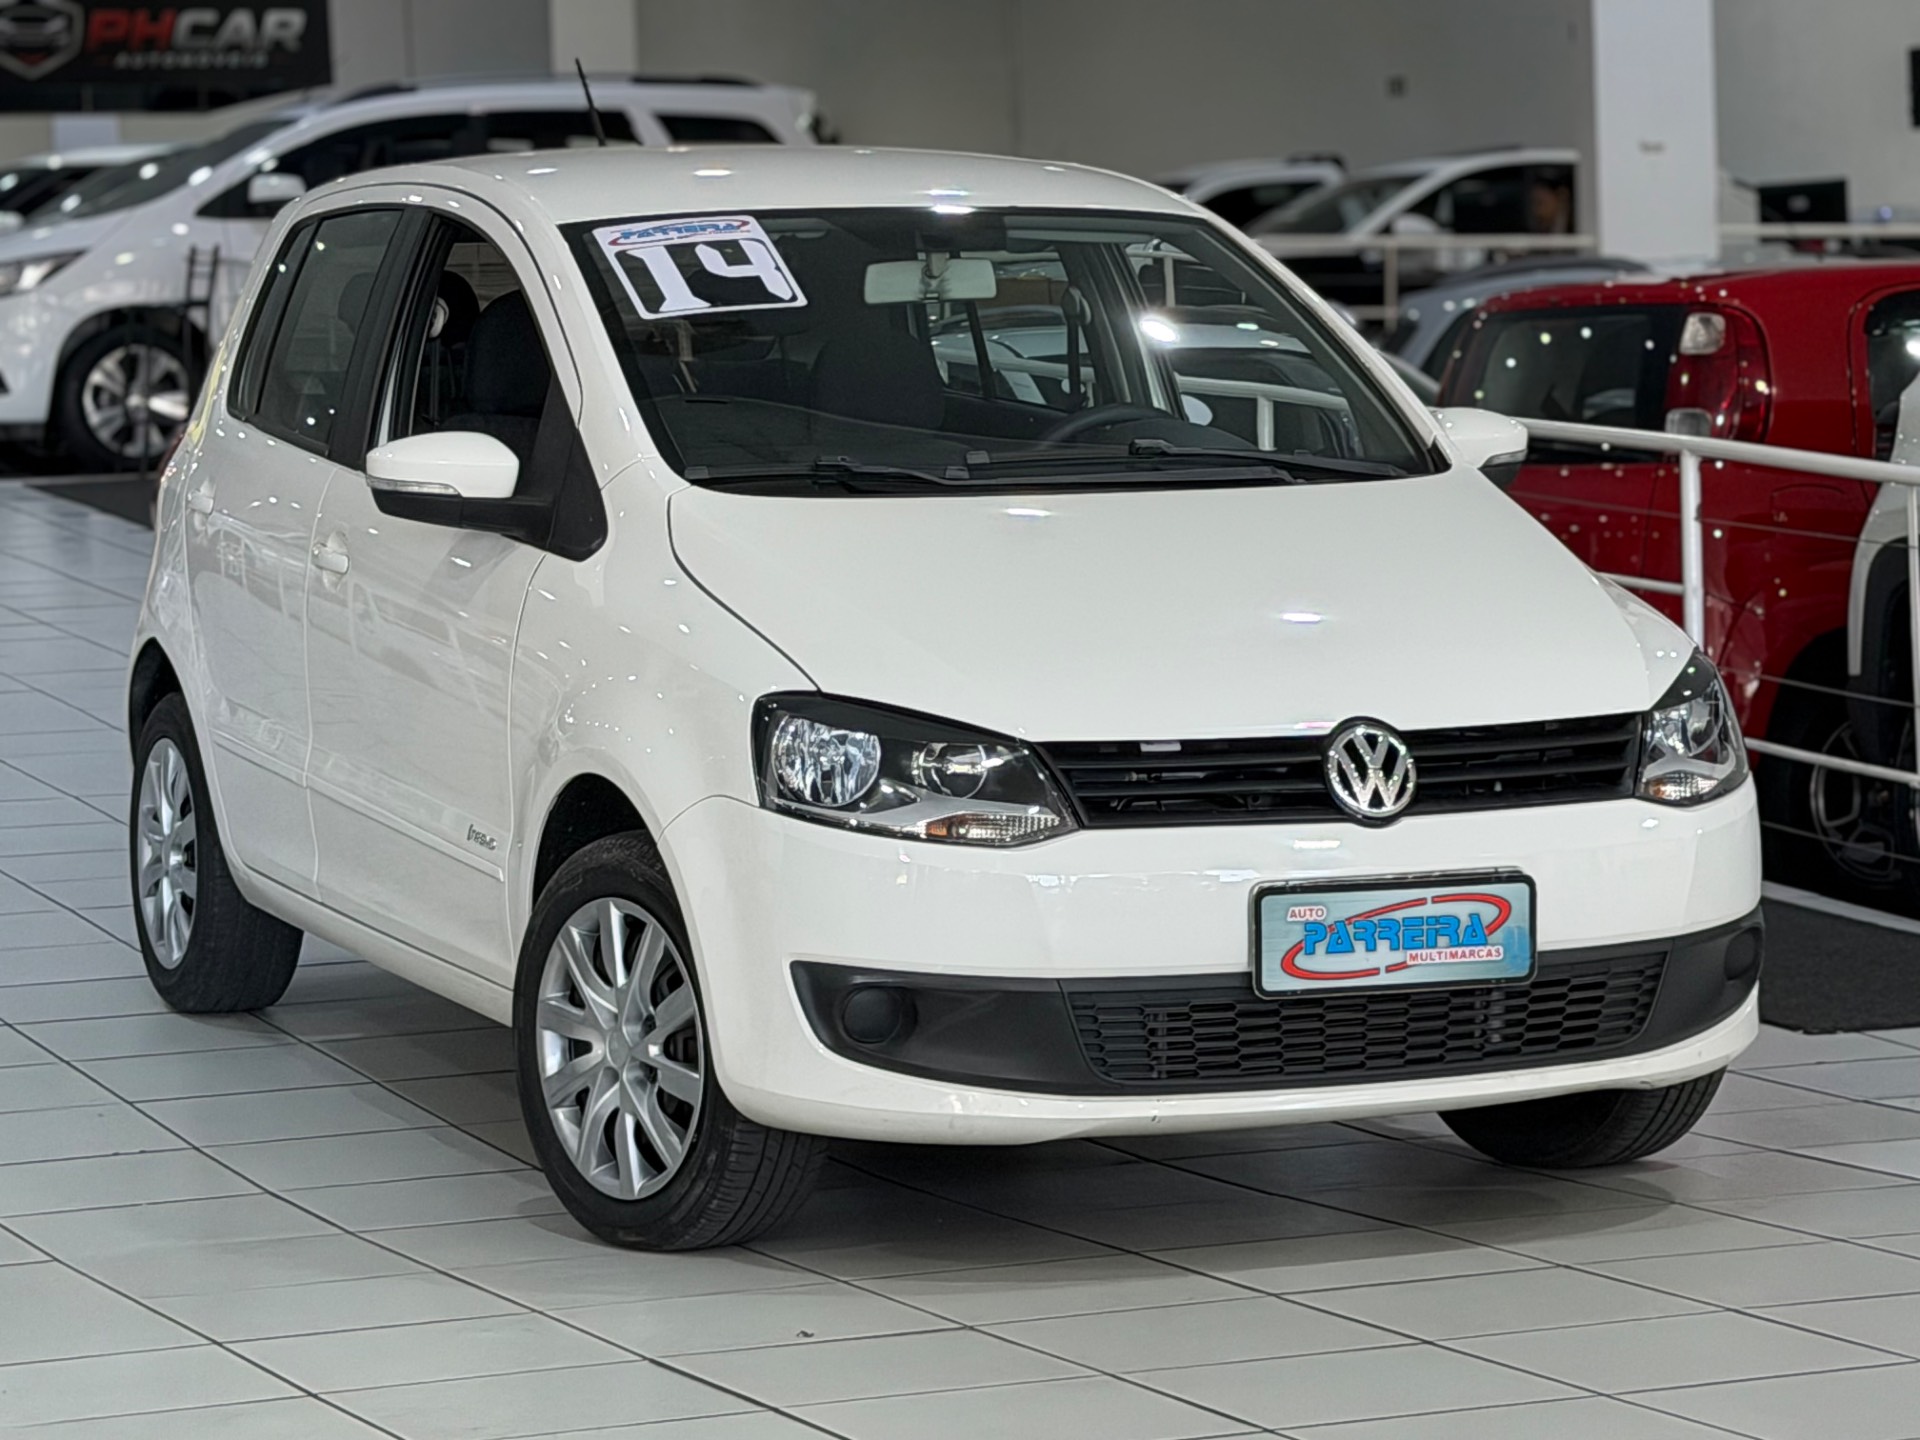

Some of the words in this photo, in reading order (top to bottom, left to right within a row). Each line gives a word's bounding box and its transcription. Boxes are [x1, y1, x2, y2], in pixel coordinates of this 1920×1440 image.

[87, 8, 308, 50] PHCAR
[626, 238, 794, 312] 14
[1288, 906, 1326, 920] AUTO
[1304, 913, 1488, 955] PARREIRA
[1408, 947, 1502, 963] MULTIMARCAS
